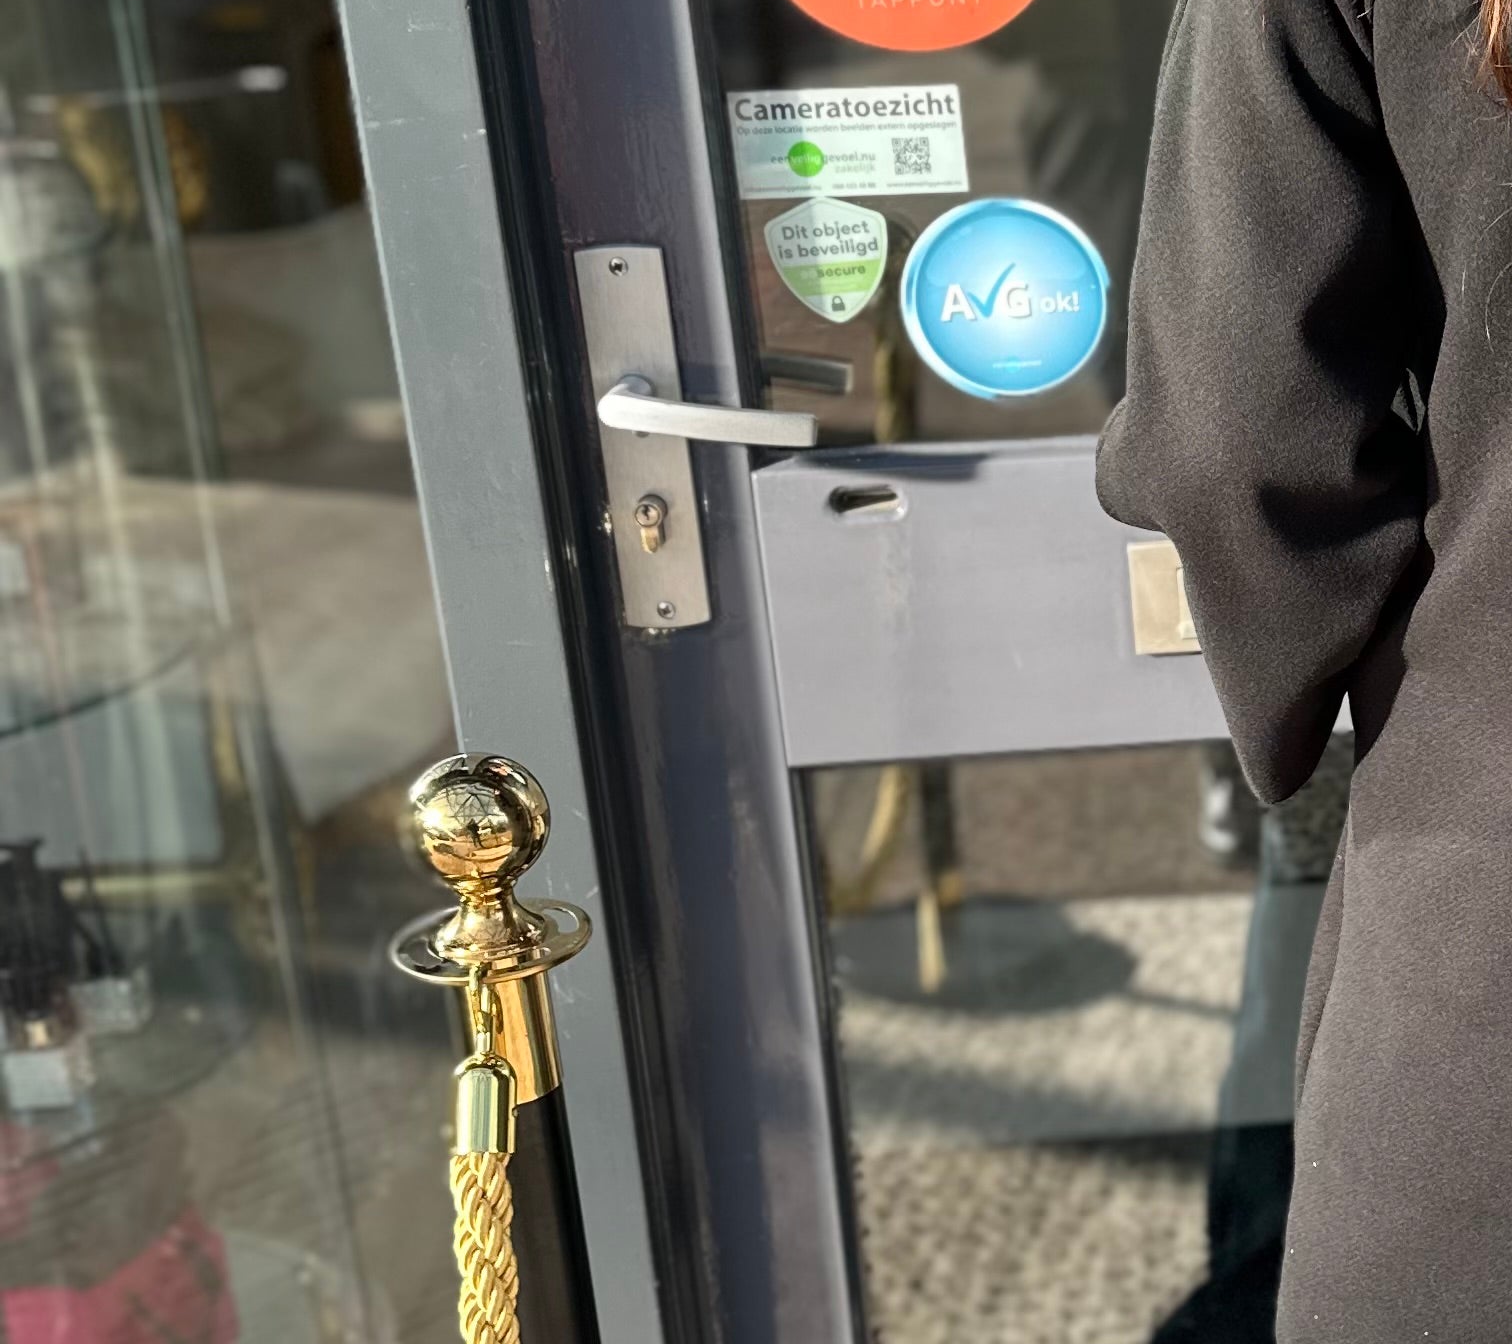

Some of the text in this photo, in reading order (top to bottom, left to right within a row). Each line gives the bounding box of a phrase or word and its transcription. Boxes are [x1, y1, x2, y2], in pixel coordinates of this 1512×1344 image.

[734, 92, 956, 122] Cameratoezicht
[752, 126, 774, 135] deze
[774, 125, 803, 134] locatie
[806, 123, 840, 132] worden
[781, 220, 870, 240] Dit object
[778, 237, 879, 259] is beveiligd
[1039, 290, 1081, 313] ok!
